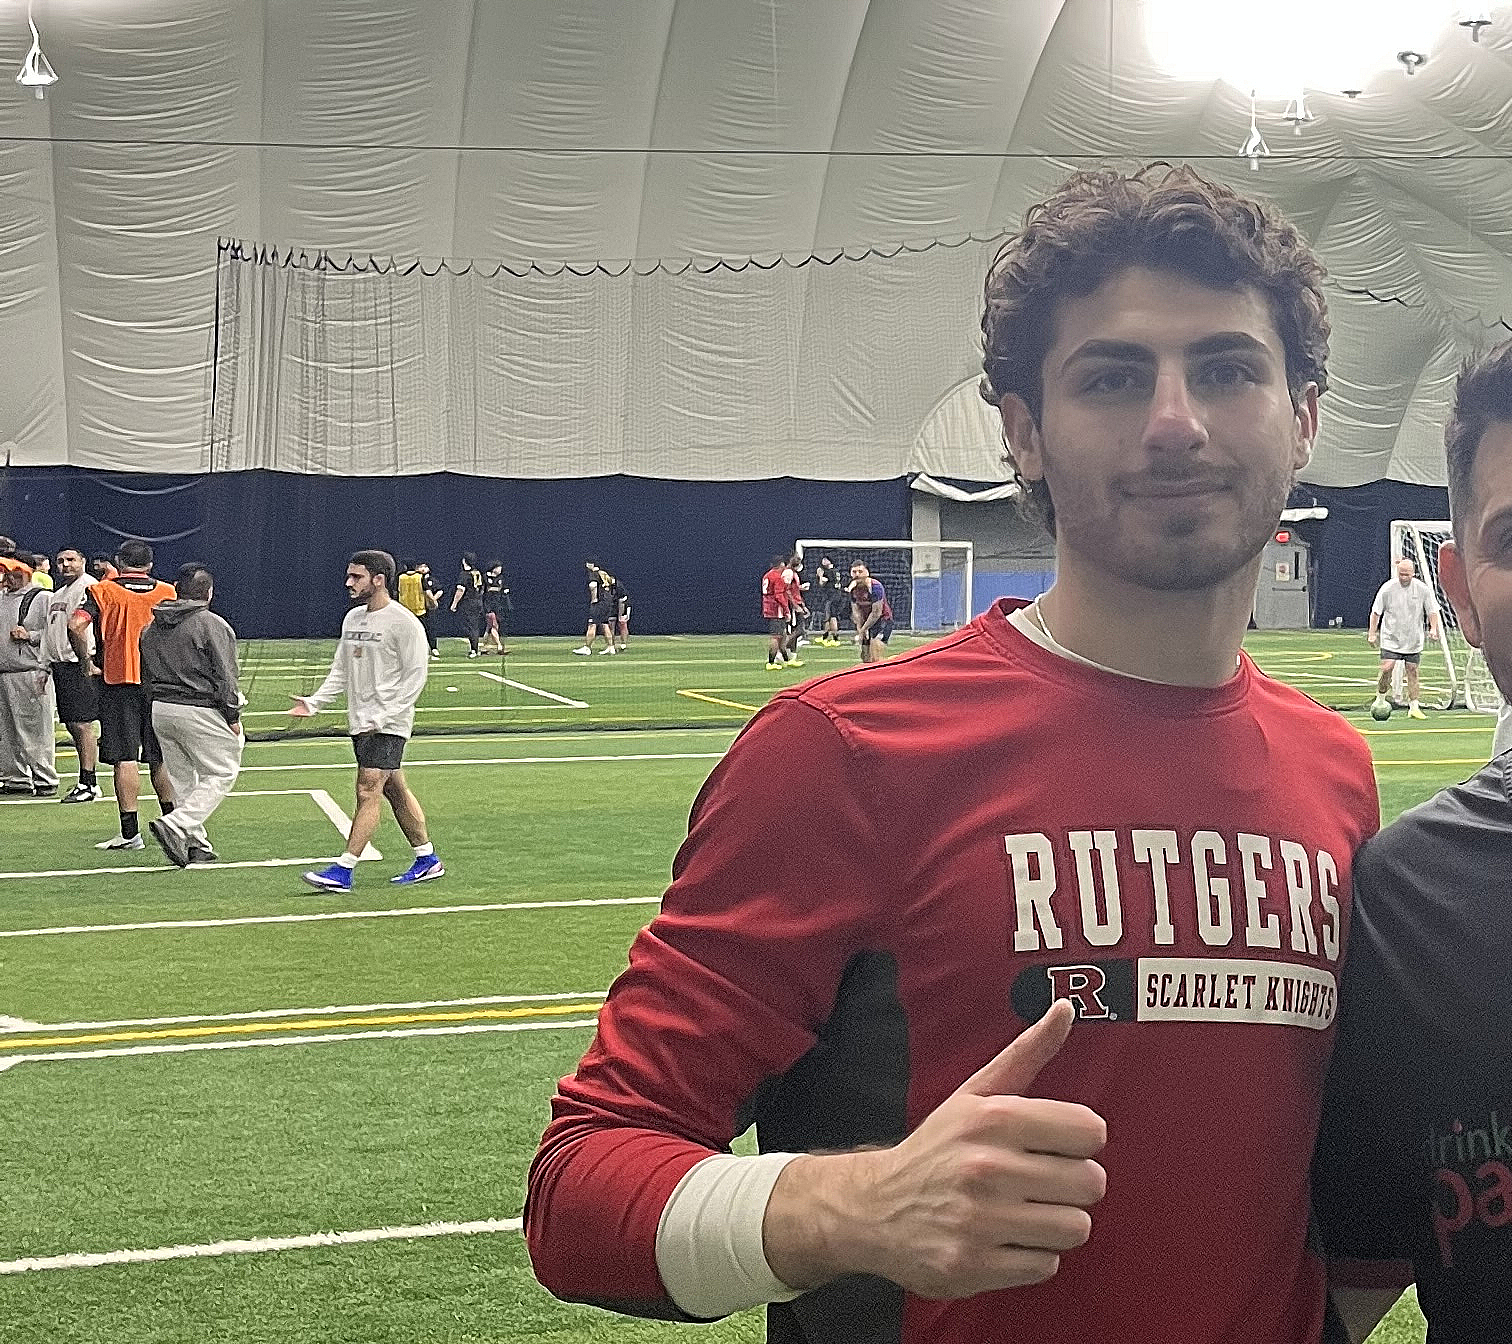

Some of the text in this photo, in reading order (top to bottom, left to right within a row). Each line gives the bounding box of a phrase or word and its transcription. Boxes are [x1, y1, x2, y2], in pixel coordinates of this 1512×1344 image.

[1004, 829, 1341, 961] RUTGERS
[1046, 964, 1109, 1019] R
[1145, 972, 1335, 1021] SCARLET KNIGHTS
